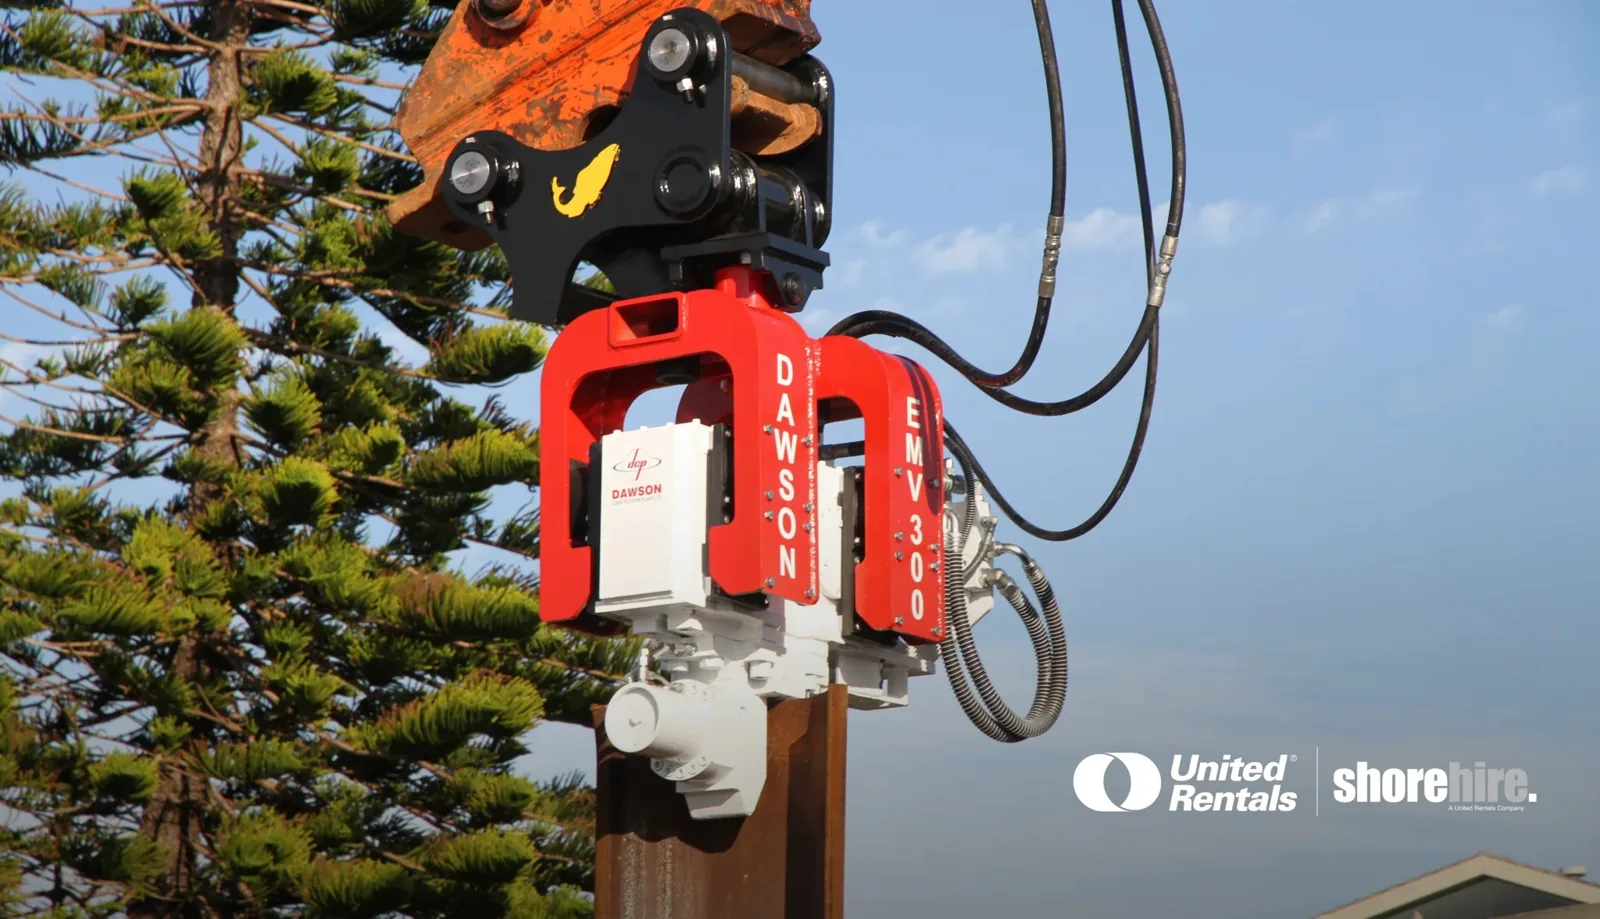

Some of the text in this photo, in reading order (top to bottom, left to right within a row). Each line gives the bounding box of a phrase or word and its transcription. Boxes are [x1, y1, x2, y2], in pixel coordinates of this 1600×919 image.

[612, 484, 662, 500] DAWSON
[773, 353, 798, 580] DAWSON
[905, 396, 924, 621] EMV 300
